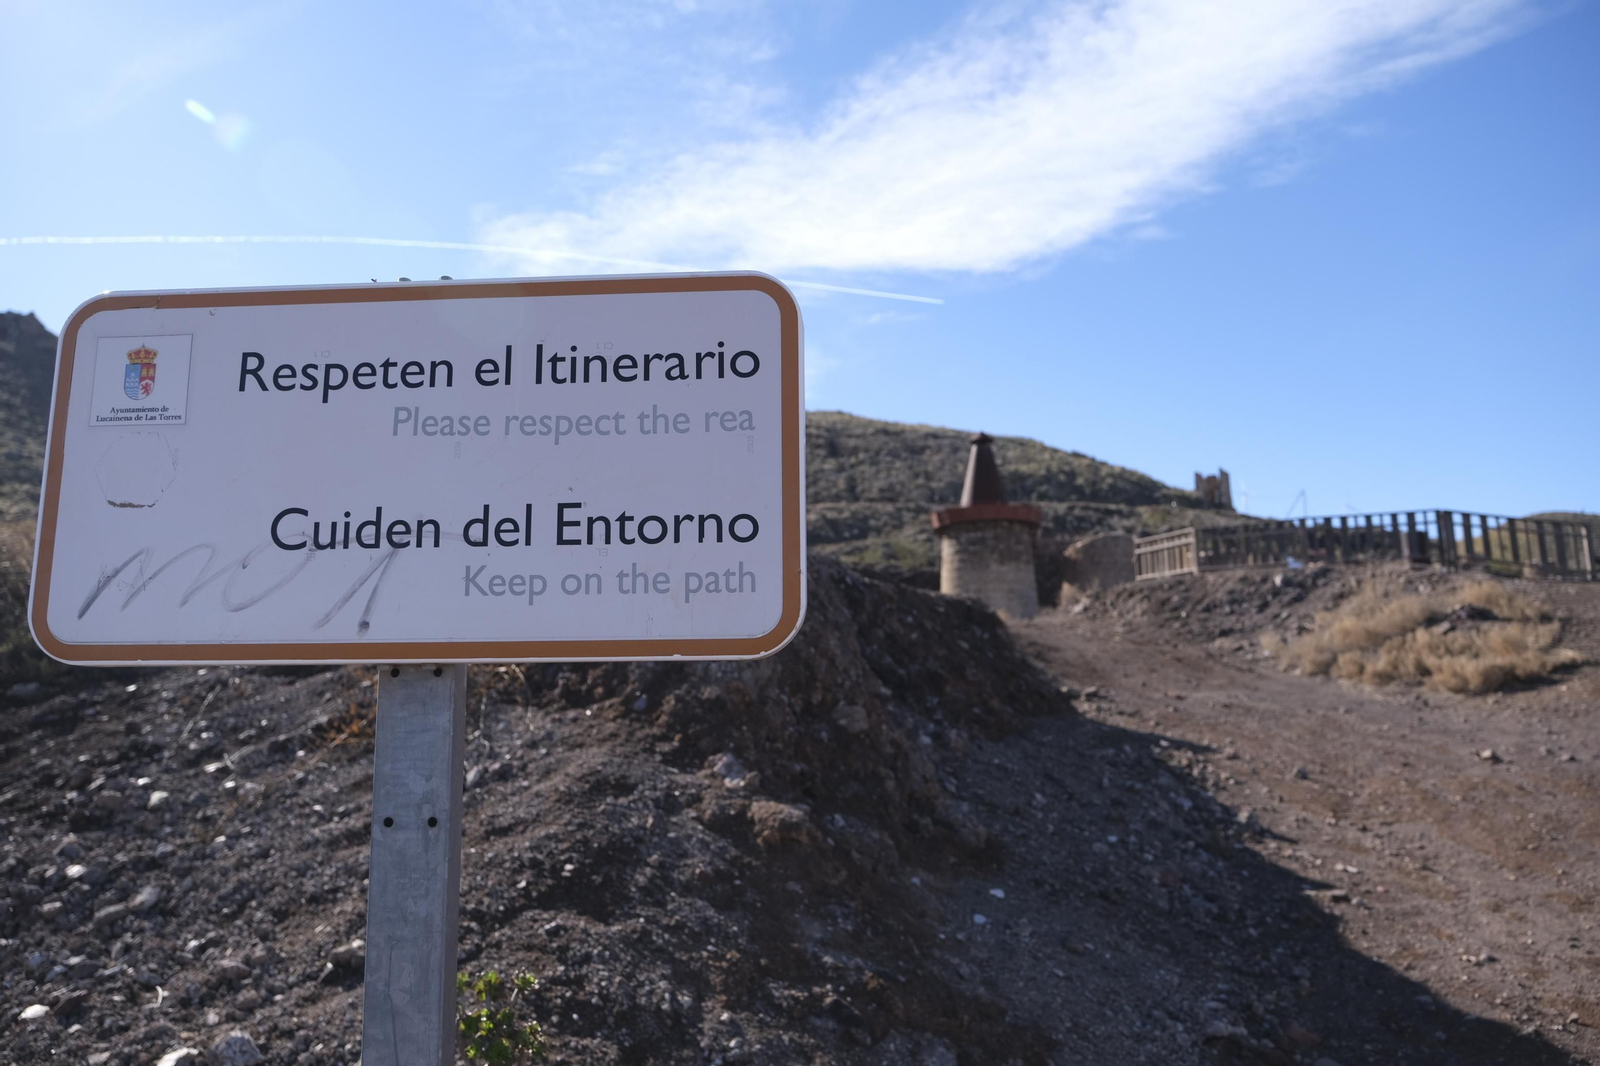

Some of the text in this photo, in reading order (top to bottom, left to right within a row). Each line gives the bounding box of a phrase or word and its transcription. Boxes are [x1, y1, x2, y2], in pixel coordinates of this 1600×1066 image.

[238, 341, 761, 404] Respeten el Itinerario
[96, 415, 133, 423] Lucainena
[158, 413, 182, 421] Torres
[110, 405, 170, 415] Ayuntamiento de
[392, 404, 756, 446] Please respect the rea
[270, 502, 760, 552] Cuiden del Entorno
[463, 561, 756, 606] Keep on the path
